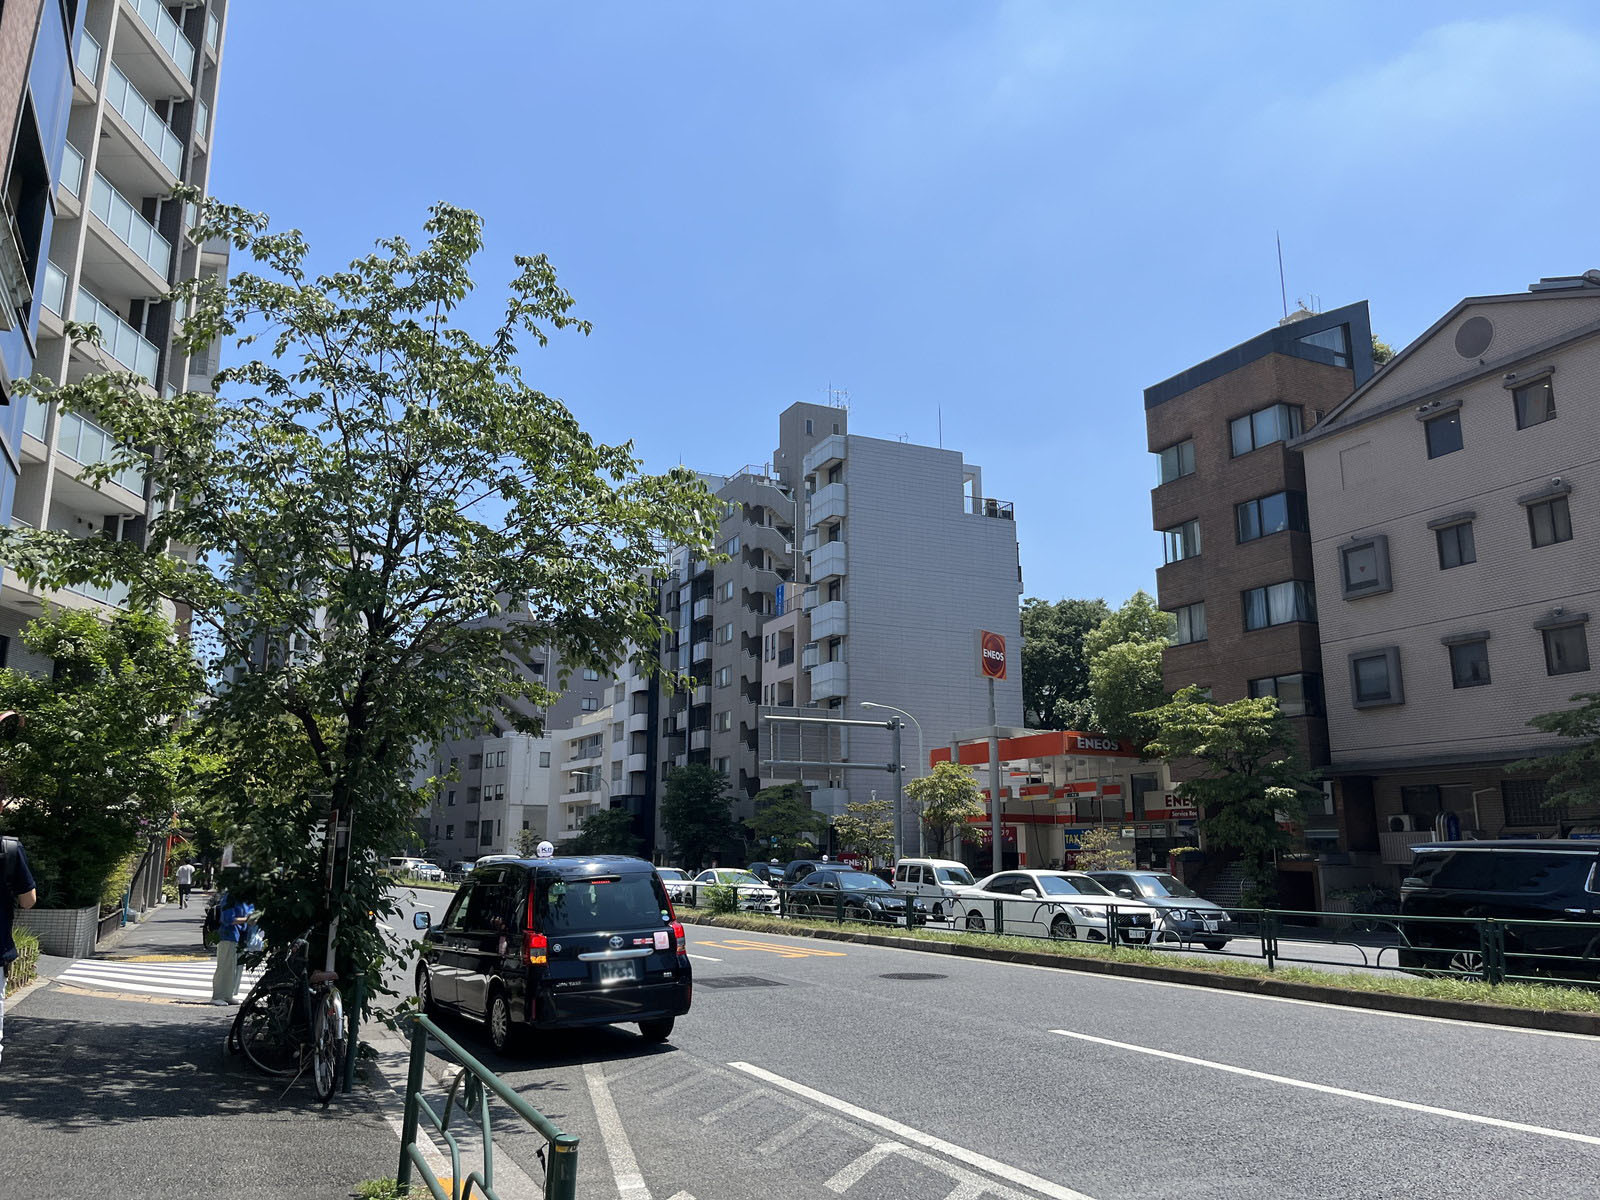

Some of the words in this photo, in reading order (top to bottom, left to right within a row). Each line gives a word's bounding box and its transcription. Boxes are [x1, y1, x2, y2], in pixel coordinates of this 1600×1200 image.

[983, 648, 1004, 662] ENEOS
[1077, 736, 1119, 751] ENEOS
[1165, 794, 1194, 807] ENE
